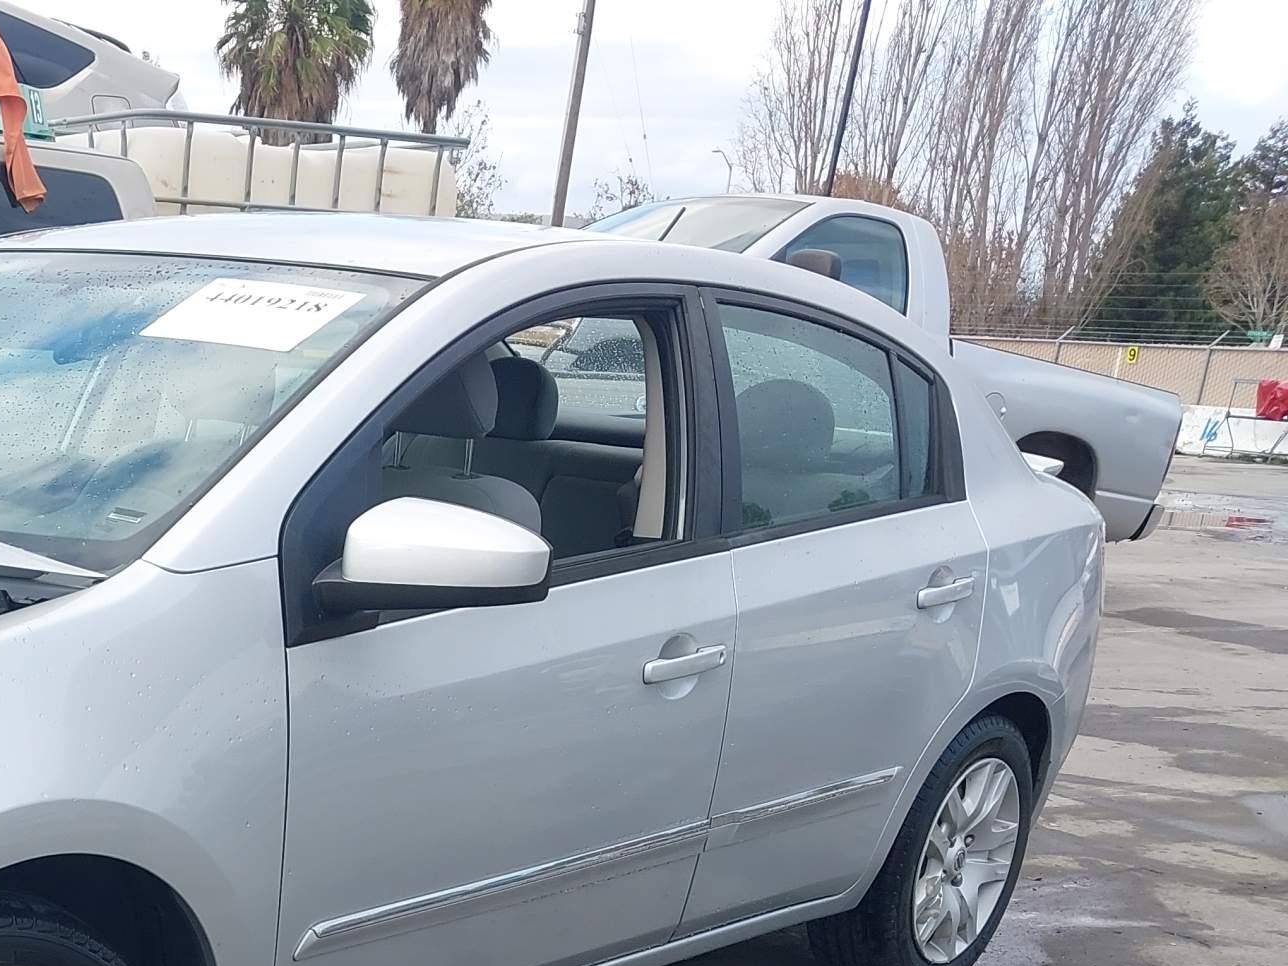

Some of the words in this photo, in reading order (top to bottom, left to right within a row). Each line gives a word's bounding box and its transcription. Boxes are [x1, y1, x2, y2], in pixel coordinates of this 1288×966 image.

[30, 91, 43, 123] 13
[206, 292, 328, 312] 44019218
[1128, 348, 1136, 361] 9
[1200, 418, 1220, 442] 16
